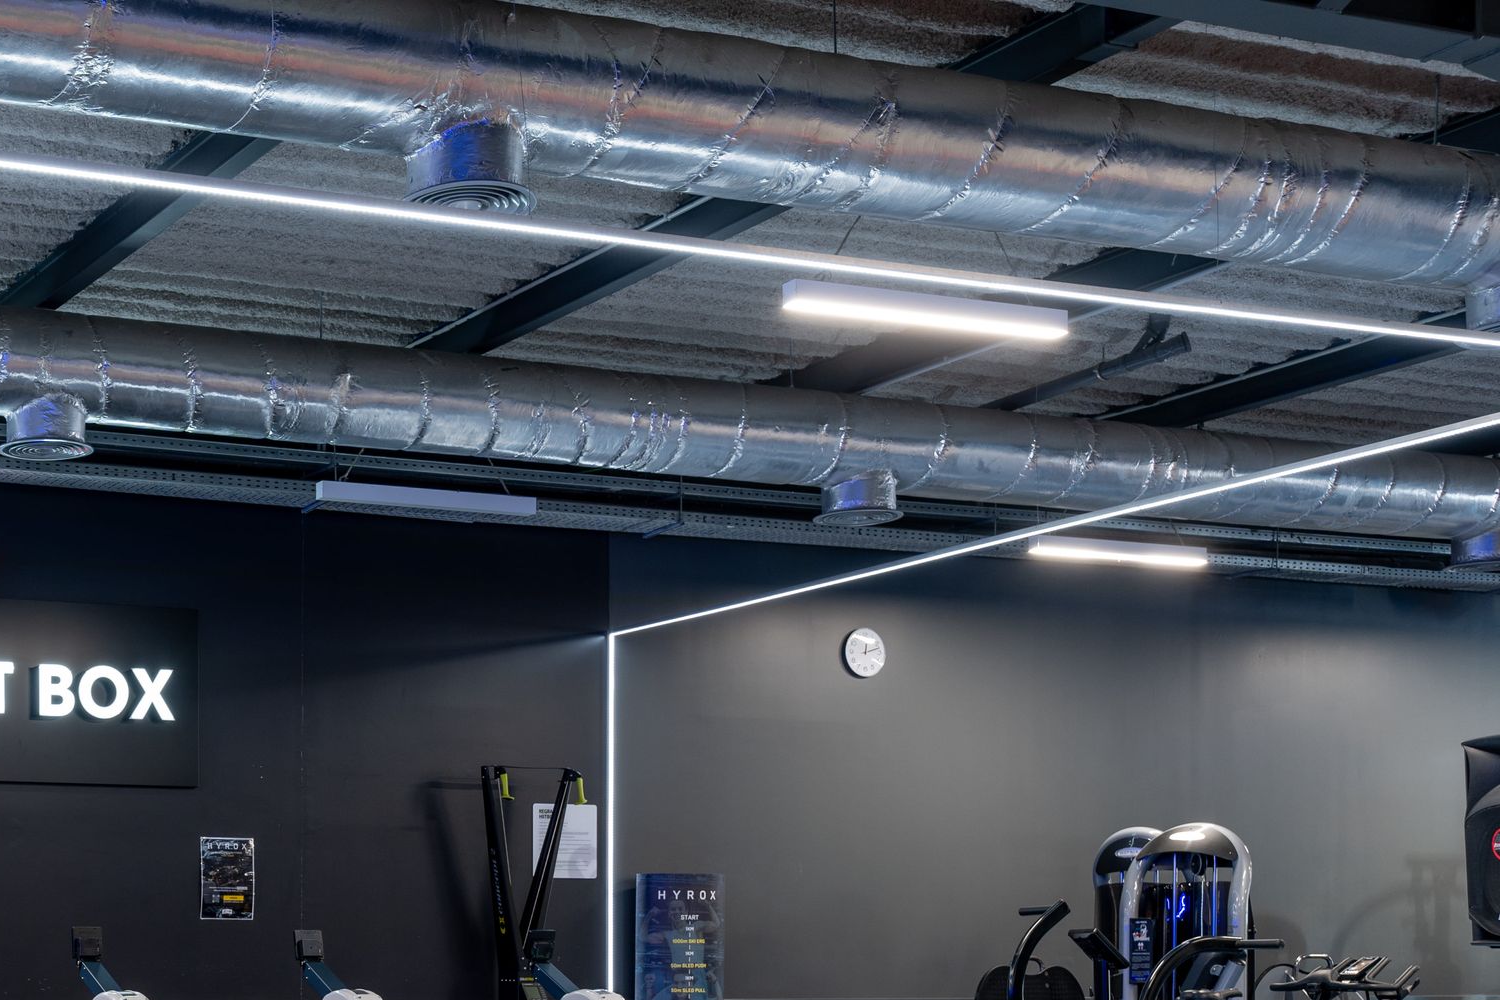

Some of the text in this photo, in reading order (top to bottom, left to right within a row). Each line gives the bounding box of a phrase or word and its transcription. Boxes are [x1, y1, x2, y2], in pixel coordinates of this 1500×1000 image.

[38, 663, 176, 721] BOX
[207, 842, 247, 850] HYROX
[657, 890, 716, 900] HYROX
